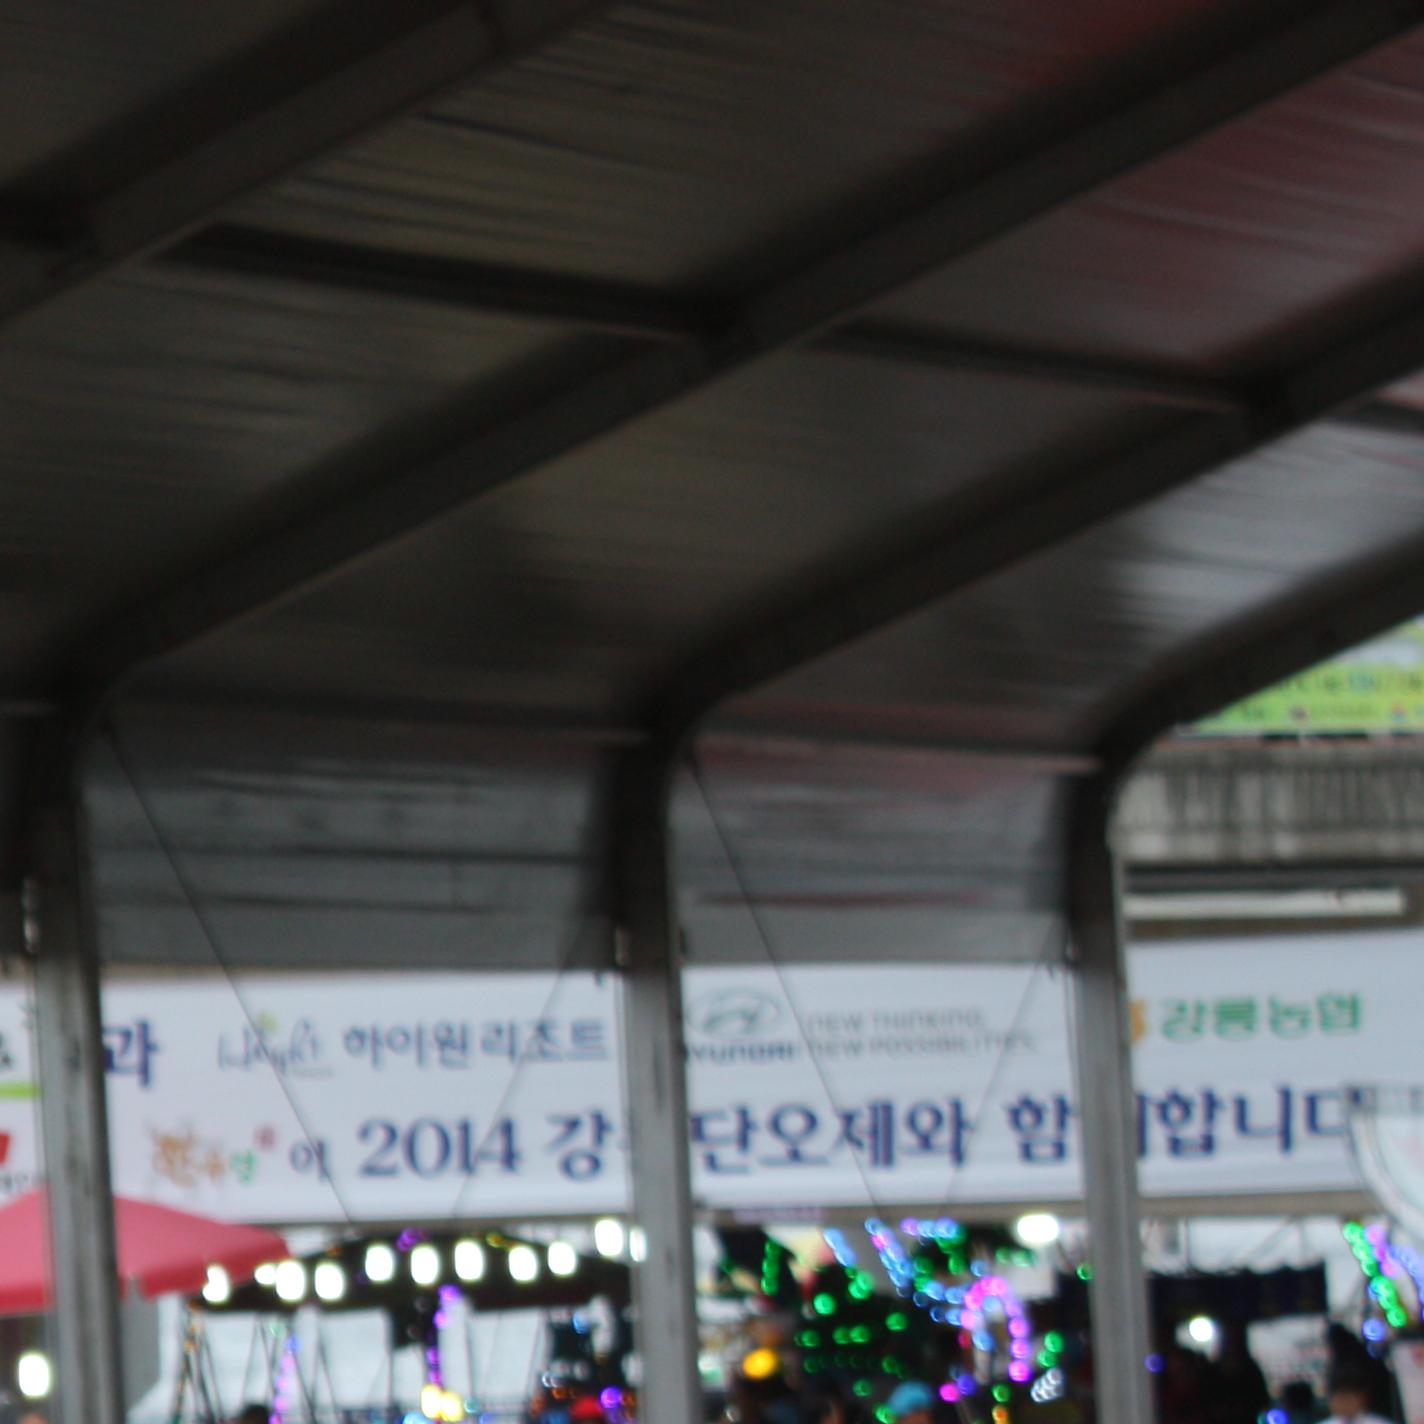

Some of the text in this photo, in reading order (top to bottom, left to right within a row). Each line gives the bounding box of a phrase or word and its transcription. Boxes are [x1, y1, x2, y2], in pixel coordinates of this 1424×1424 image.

[1160, 992, 1362, 1042] 강릉농협
[686, 1038, 795, 1064] YUNDAI
[356, 1116, 522, 1178] 2014
[548, 1094, 976, 1184] 강단오제와
[1004, 1086, 1362, 1166] 함합니다
